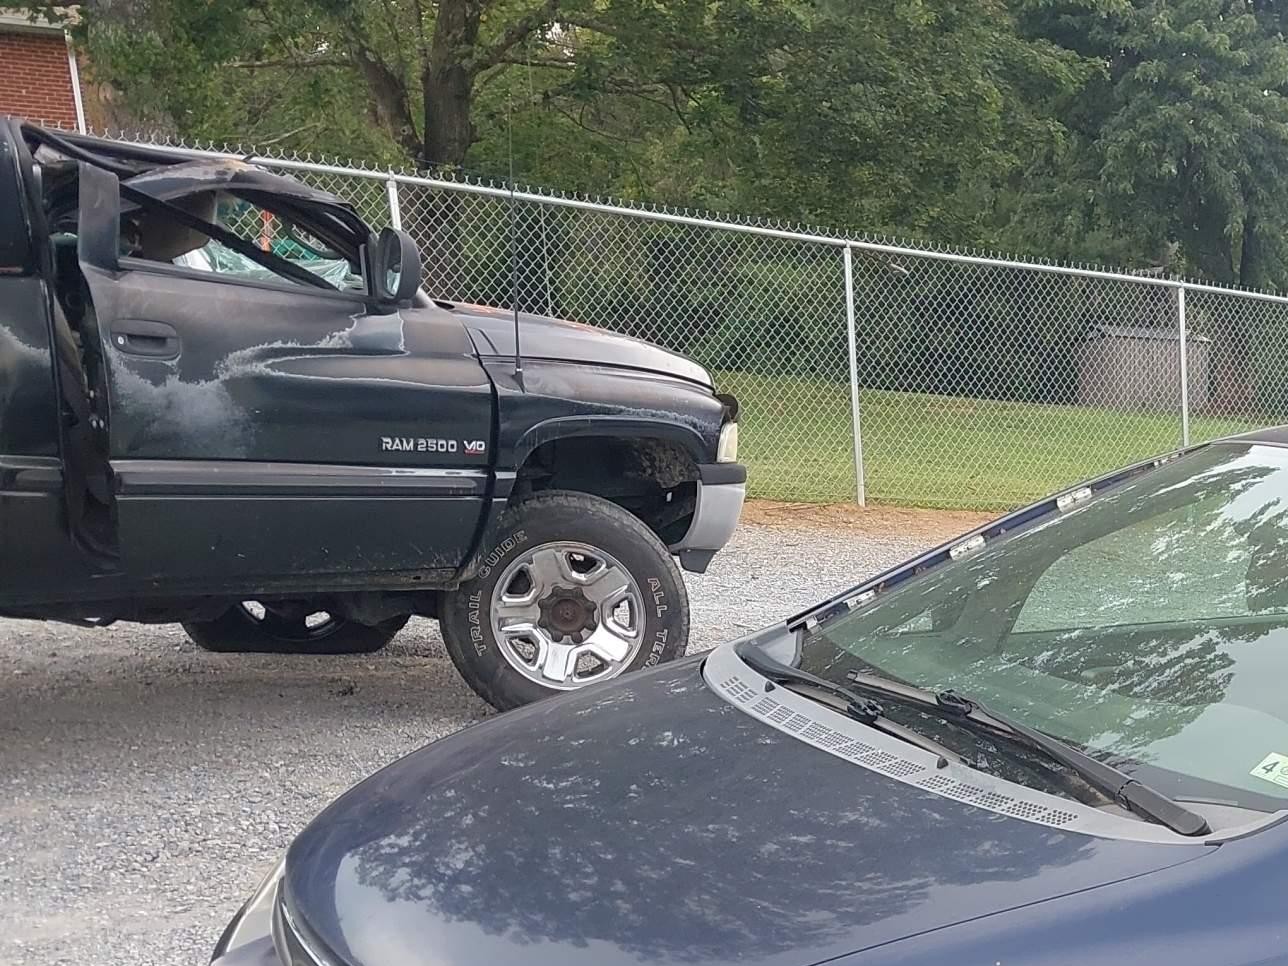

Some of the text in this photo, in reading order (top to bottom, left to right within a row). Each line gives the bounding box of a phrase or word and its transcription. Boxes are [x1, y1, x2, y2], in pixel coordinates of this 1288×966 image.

[381, 437, 414, 451] RAM
[417, 438, 457, 452] 2500
[468, 529, 528, 657] TRAIL GUIDE
[641, 577, 668, 671] ALL TER
[1261, 761, 1280, 774] 4
